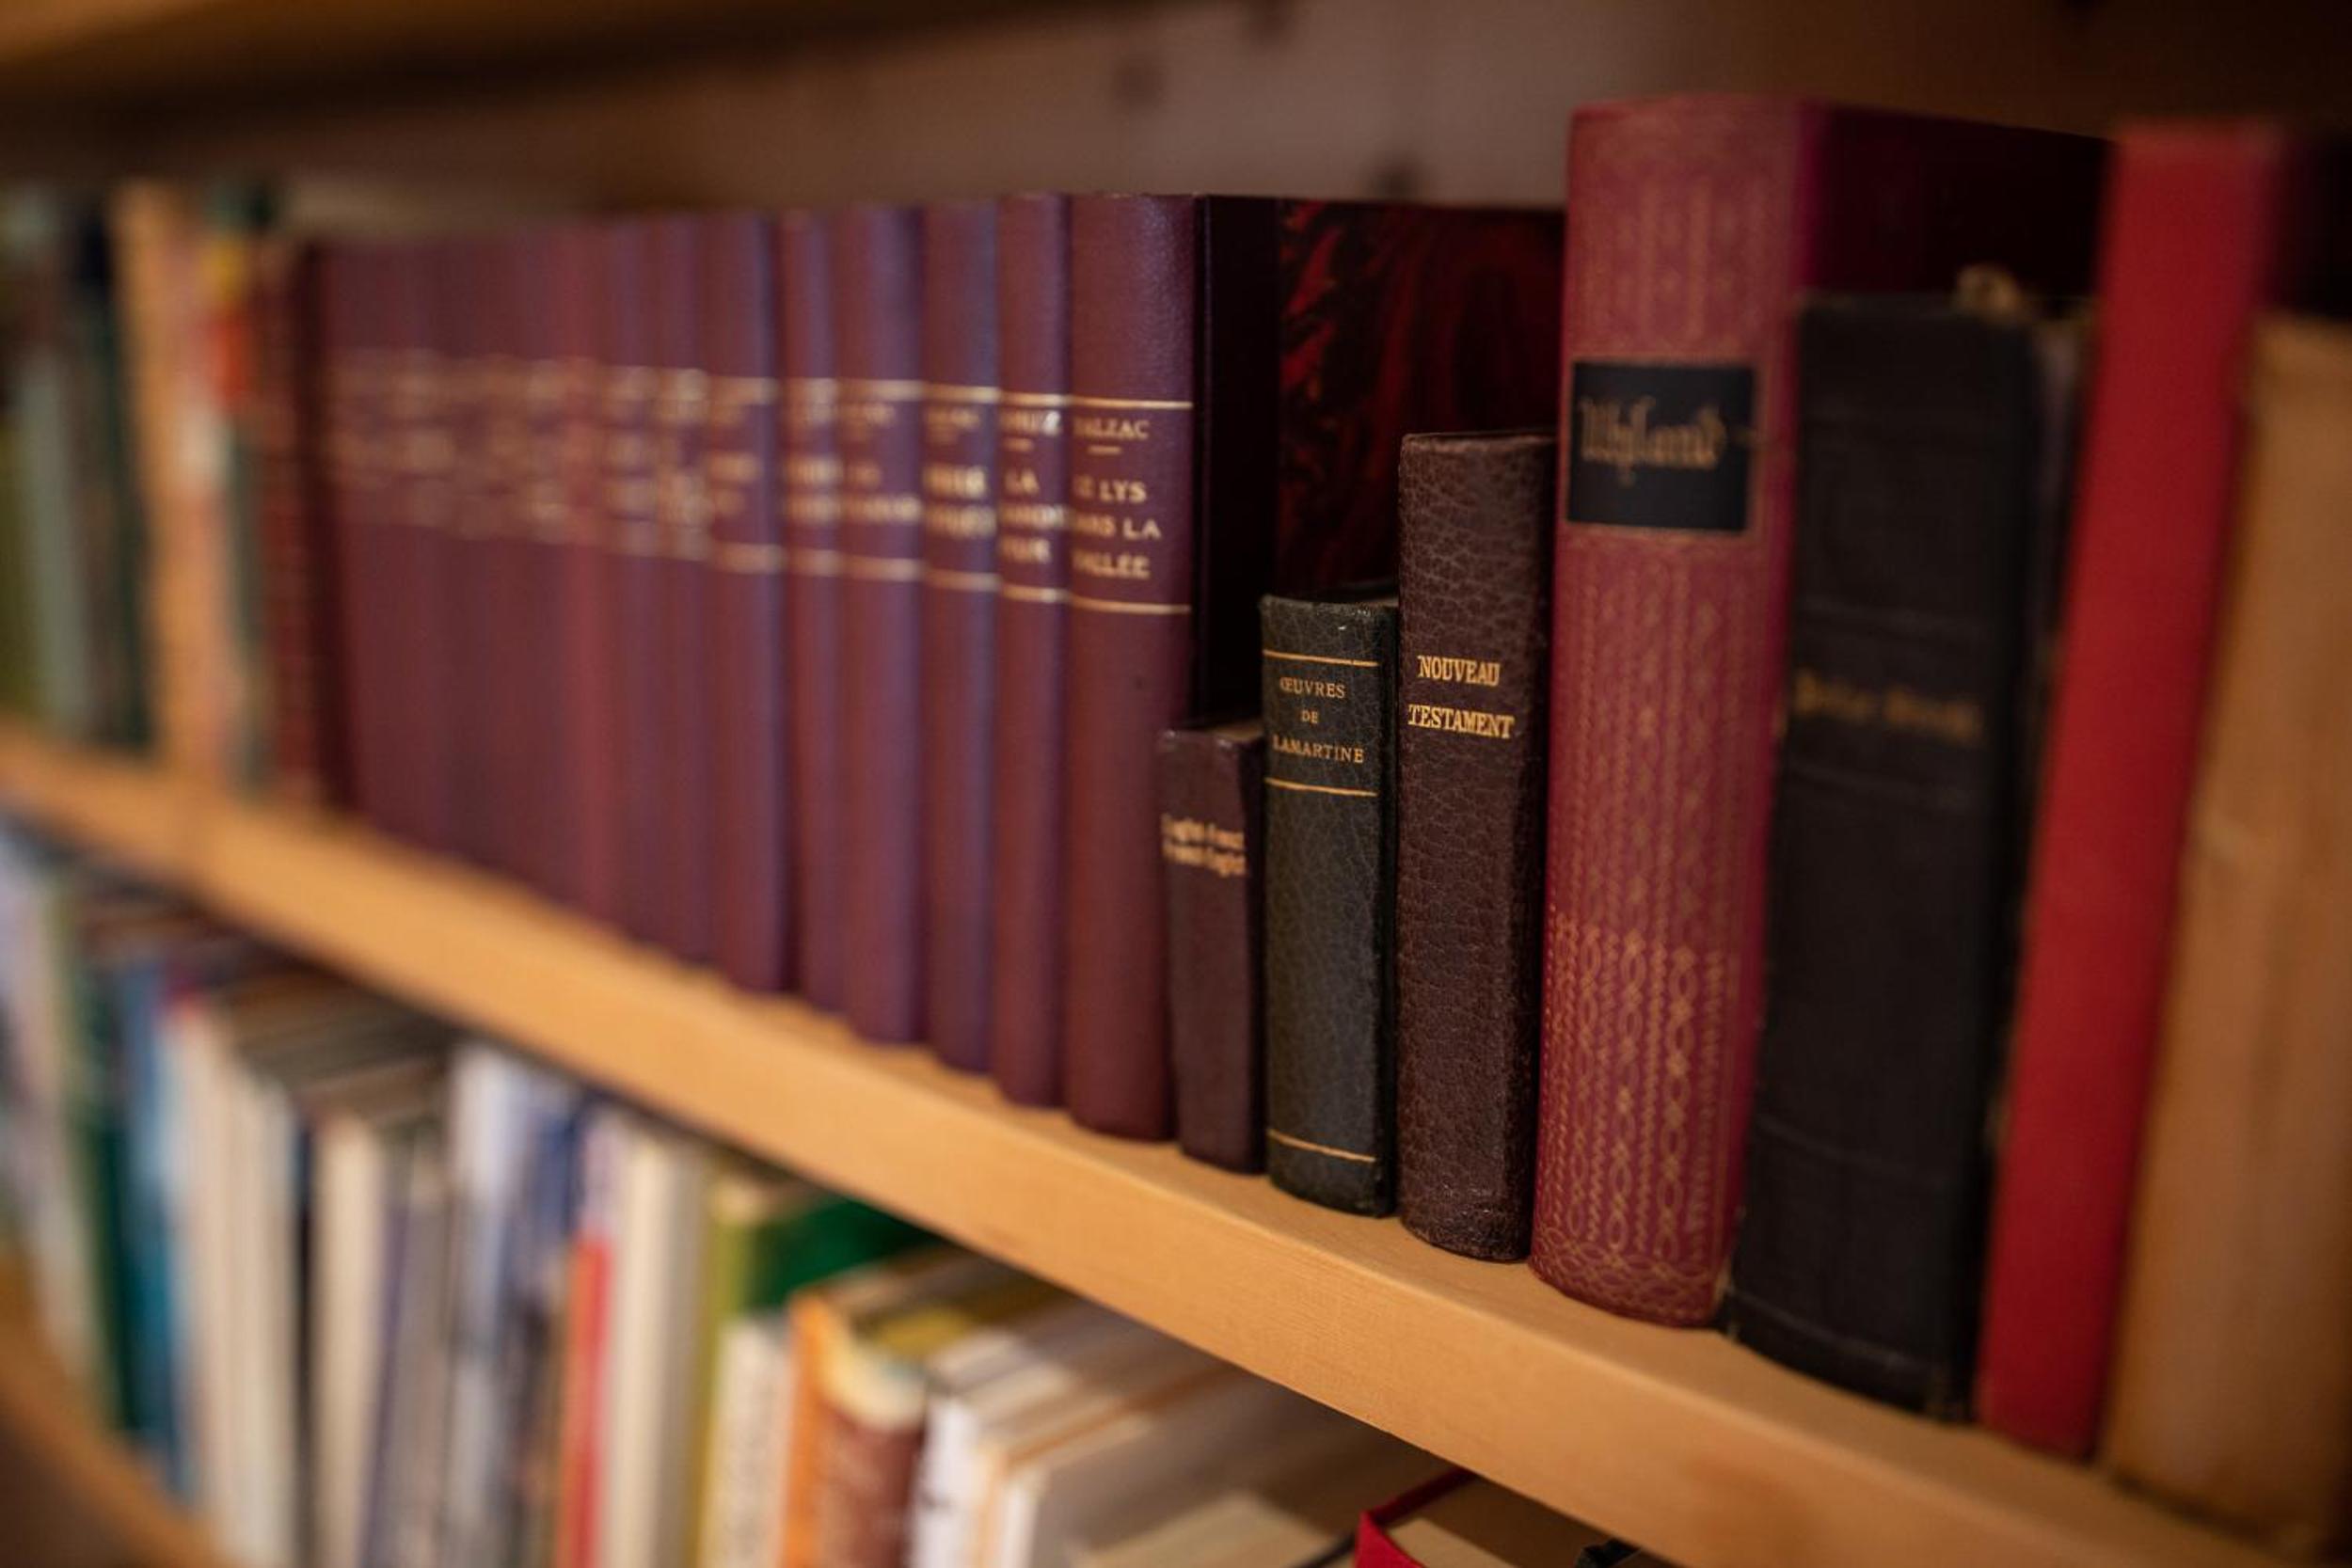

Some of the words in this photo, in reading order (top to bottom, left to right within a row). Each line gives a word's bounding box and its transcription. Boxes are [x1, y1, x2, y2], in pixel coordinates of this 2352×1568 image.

[1099, 479, 1148, 503] LYS
[1122, 518, 1162, 541] LA
[1417, 655, 1502, 687] NOUVEAU
[1279, 677, 1346, 699] ŒUVRES
[1300, 709, 1319, 725] DE
[1407, 704, 1515, 739] TESTAMENT
[1273, 735, 1365, 764] LAMARTINE
